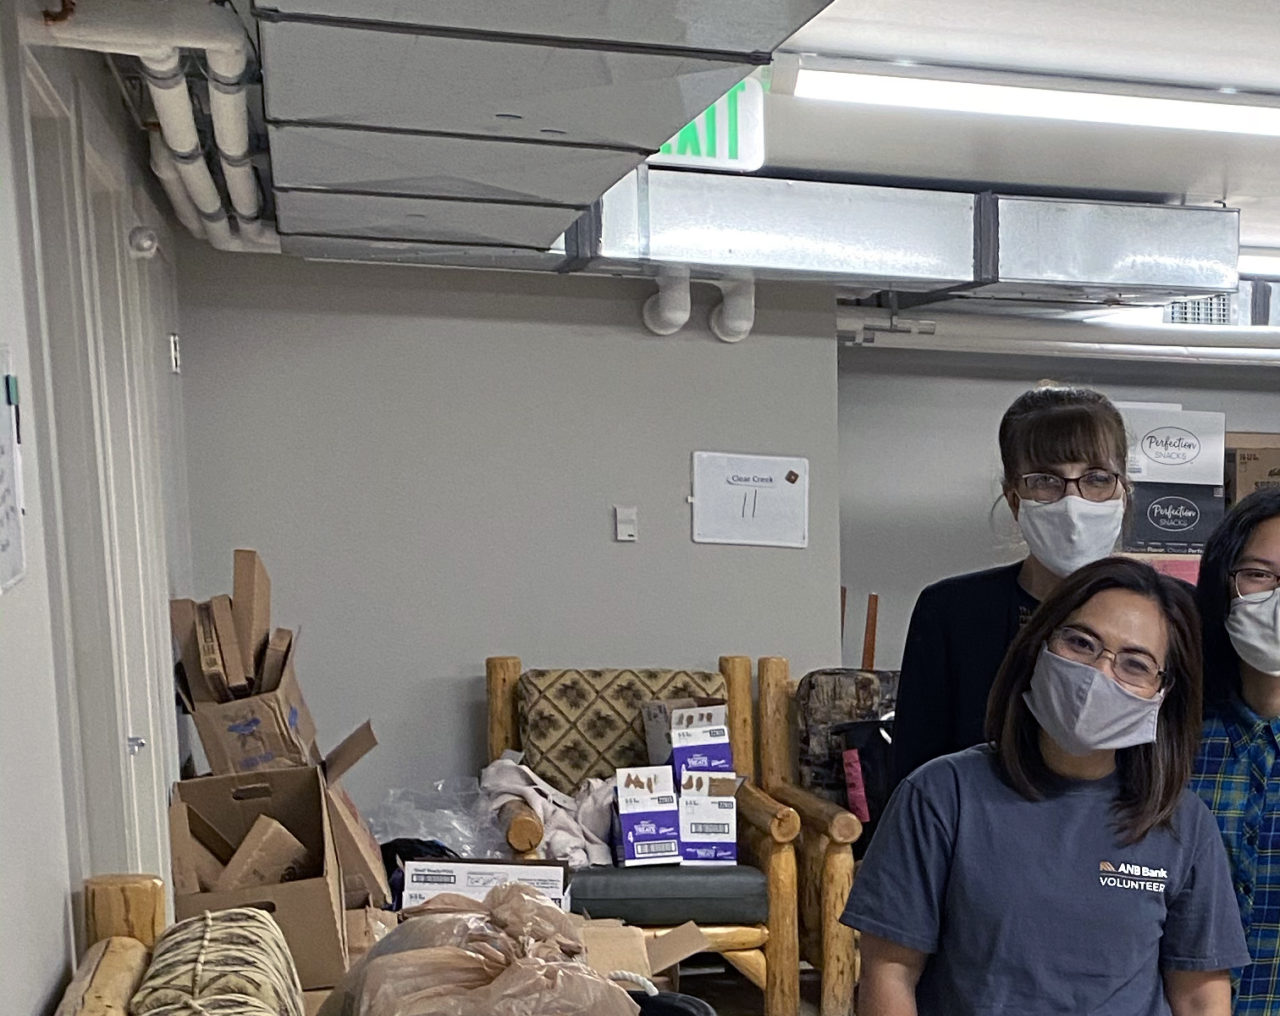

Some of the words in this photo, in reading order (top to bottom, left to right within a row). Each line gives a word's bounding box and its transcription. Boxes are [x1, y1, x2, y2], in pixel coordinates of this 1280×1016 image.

[661, 81, 746, 160] IT
[1146, 435, 1197, 451] Perfection
[1155, 451, 1187, 460] SNACKS
[731, 474, 750, 482] Clear
[752, 475, 773, 483] Creek
[742, 489, 757, 518] 11
[1152, 503, 1197, 519] Perfection
[1160, 518, 1188, 527] SNACKS
[1117, 863, 1141, 876] ANB
[1142, 866, 1168, 879] Bank
[1099, 876, 1166, 893] VOLUNTEER
